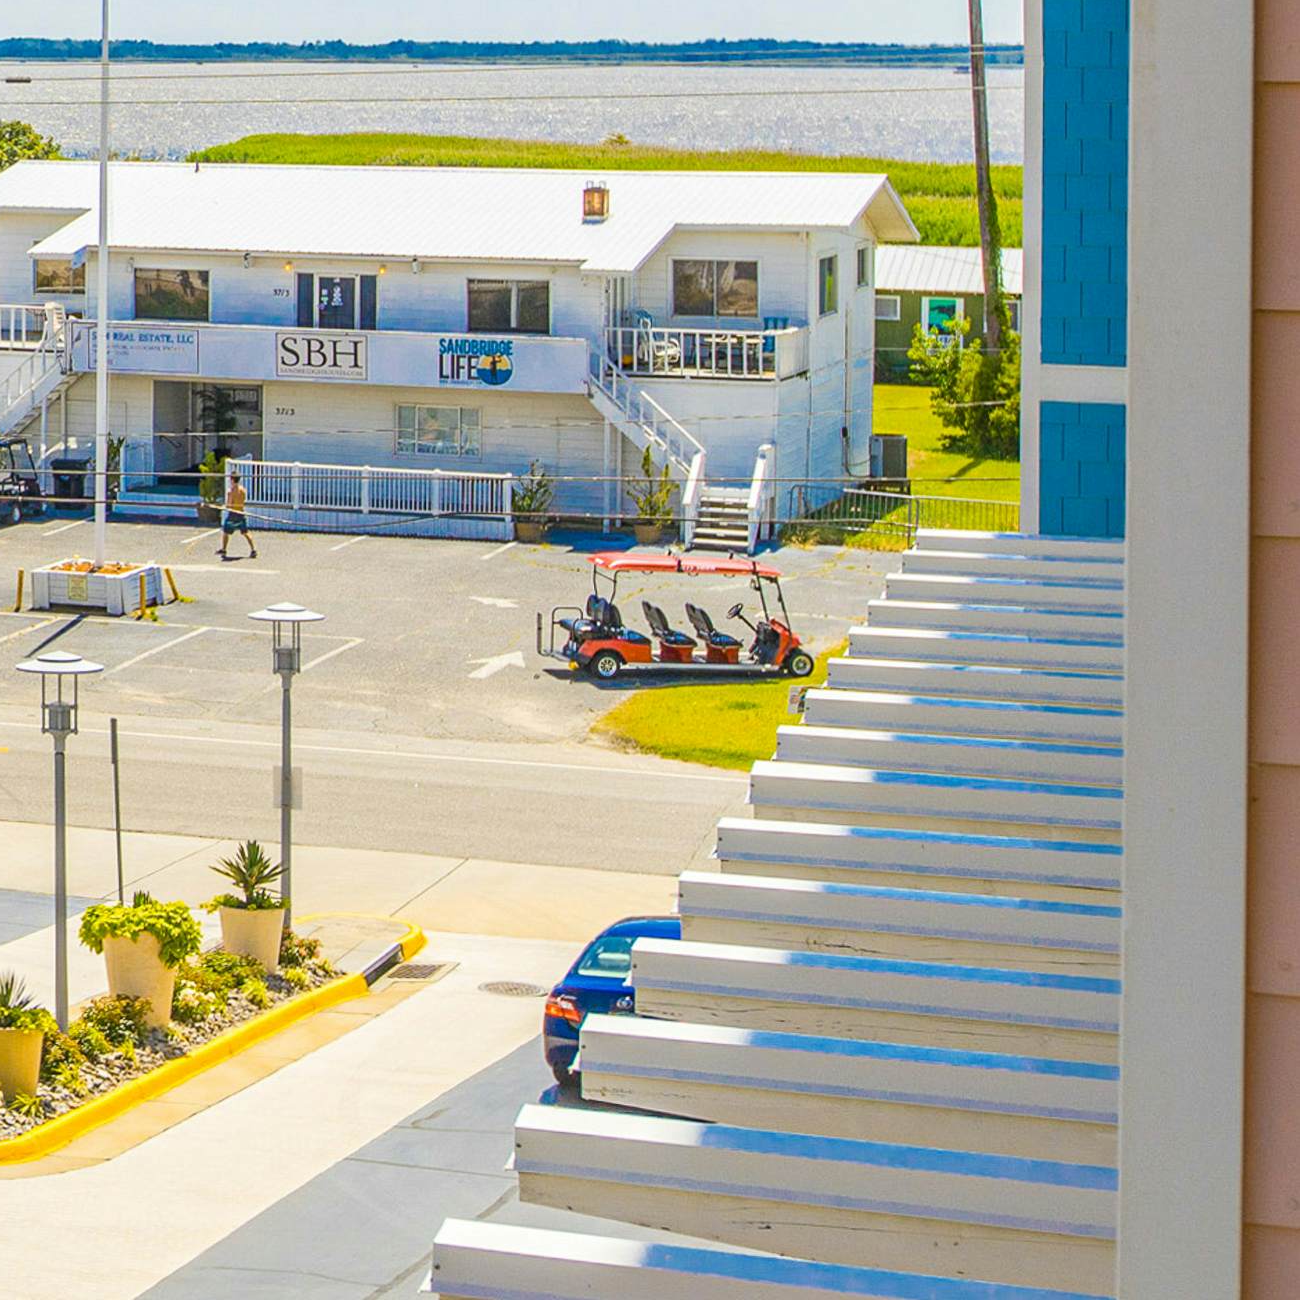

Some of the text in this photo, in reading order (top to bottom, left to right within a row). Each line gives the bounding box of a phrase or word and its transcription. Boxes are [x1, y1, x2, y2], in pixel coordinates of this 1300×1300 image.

[113, 331, 135, 342] REAL
[177, 334, 195, 344] LLC
[438, 338, 514, 356] SANDBRIDGE
[280, 336, 364, 369] SBH
[439, 354, 481, 380] LIFE
